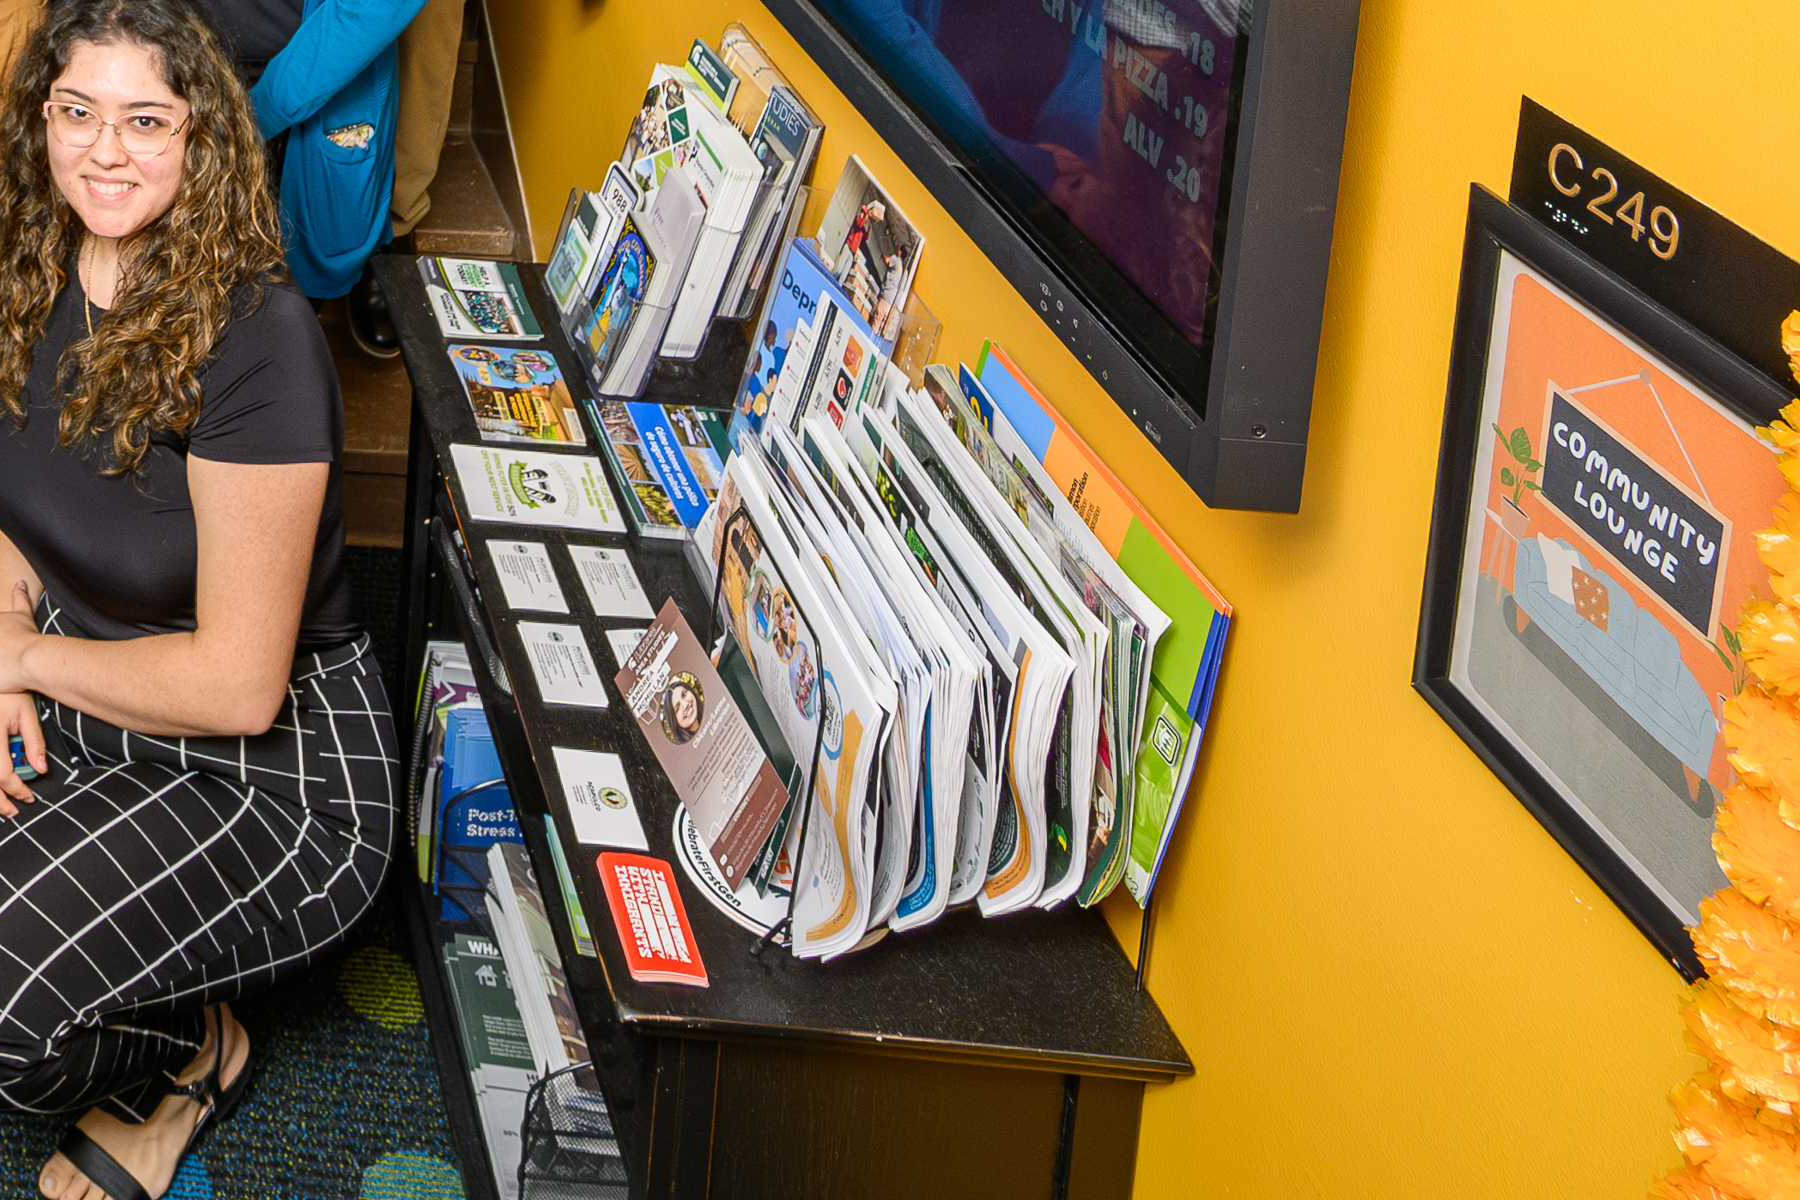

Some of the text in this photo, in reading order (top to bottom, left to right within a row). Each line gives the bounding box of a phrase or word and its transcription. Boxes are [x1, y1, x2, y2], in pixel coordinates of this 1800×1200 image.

[1085, 15, 1108, 61] LA
[1113, 35, 1170, 111] PIZZA
[1174, 95, 1209, 138] .19
[1123, 113, 1201, 202] ALV .20
[609, 188, 629, 214] 988
[1547, 142, 1681, 261] C249
[649, 445, 666, 464] seguro
[664, 472, 685, 500] cultivos
[662, 445, 683, 473] obtener
[676, 472, 689, 487] una
[491, 490, 505, 513] SERVICE
[1553, 422, 1716, 566] COMMUNITY
[1574, 480, 1680, 585] LOUNGE
[634, 629, 667, 676] AREA STUDIES
[631, 668, 655, 703] ANDREA
[636, 671, 666, 713] MCMILLAN
[708, 701, 732, 737] Librarian
[466, 823, 517, 838] Stress
[732, 795, 750, 823] CONTACT
[625, 866, 649, 904] WITH
[687, 818, 742, 907] elebrateFirstGen
[613, 865, 654, 960] IMMIGRANTS
[638, 868, 665, 916] STAND
